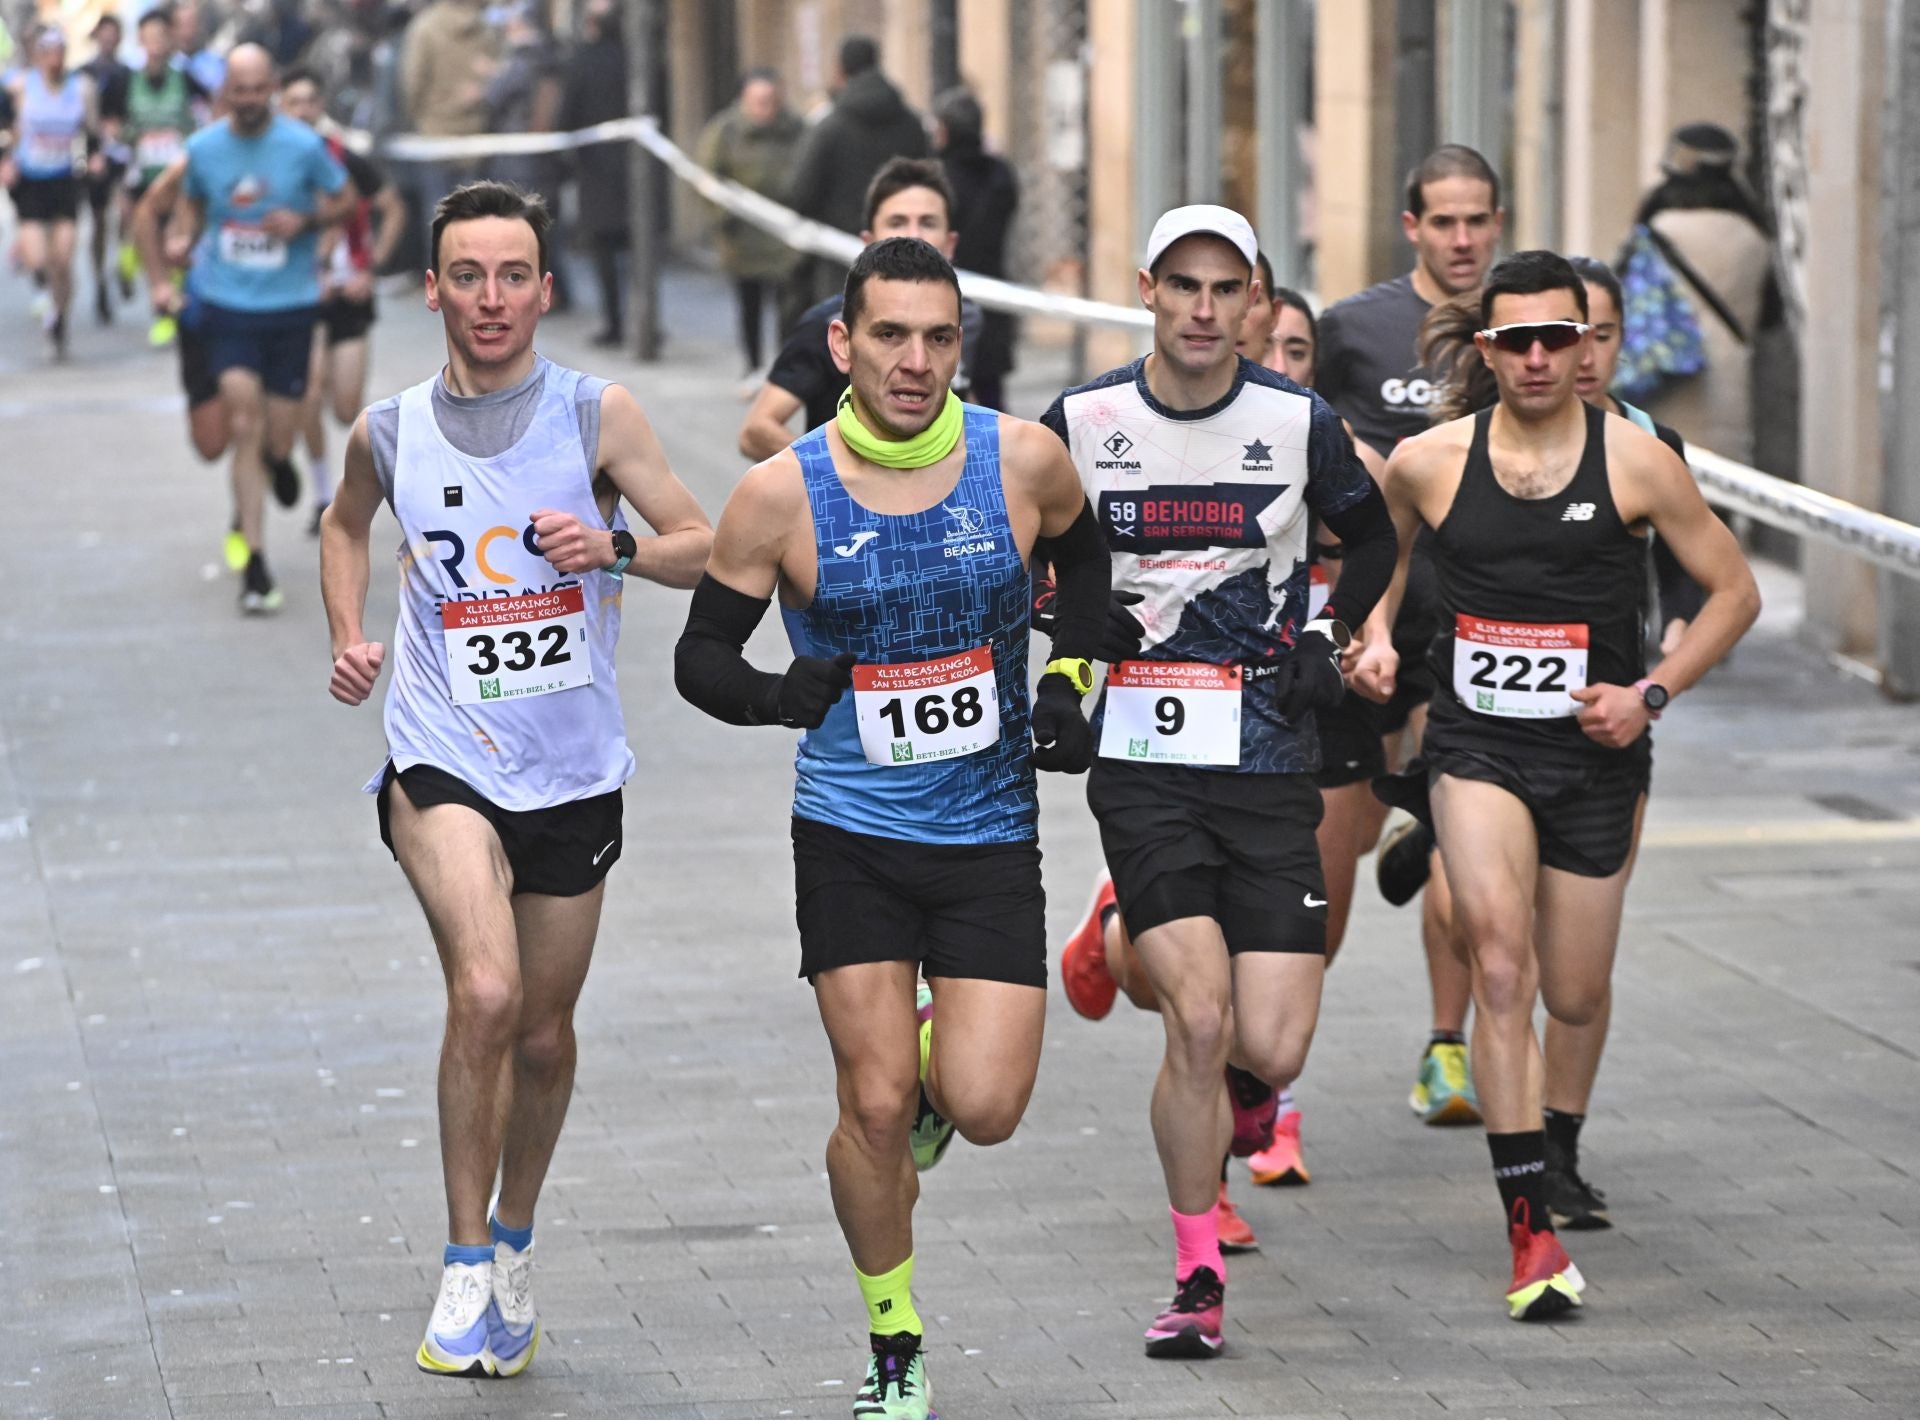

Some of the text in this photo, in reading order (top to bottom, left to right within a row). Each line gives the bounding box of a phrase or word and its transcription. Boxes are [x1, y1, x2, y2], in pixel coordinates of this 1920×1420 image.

[1096, 461, 1141, 469] FORTUNA
[1242, 463, 1273, 471] luanvi
[1109, 501, 1244, 523] 58 BEHOBIA
[1144, 526, 1242, 538] SAN SEBASTIAN
[944, 541, 995, 557] BEASAIN
[460, 605, 568, 626] SAN SILBESTRE KROSA
[466, 625, 571, 675] 332
[872, 665, 980, 689] SAN SILBESTRE KROSA
[1470, 651, 1567, 692] 222
[1122, 677, 1225, 688] SAN SILBESTRE KROSA
[879, 686, 983, 738] 168
[1155, 696, 1185, 735] 9
